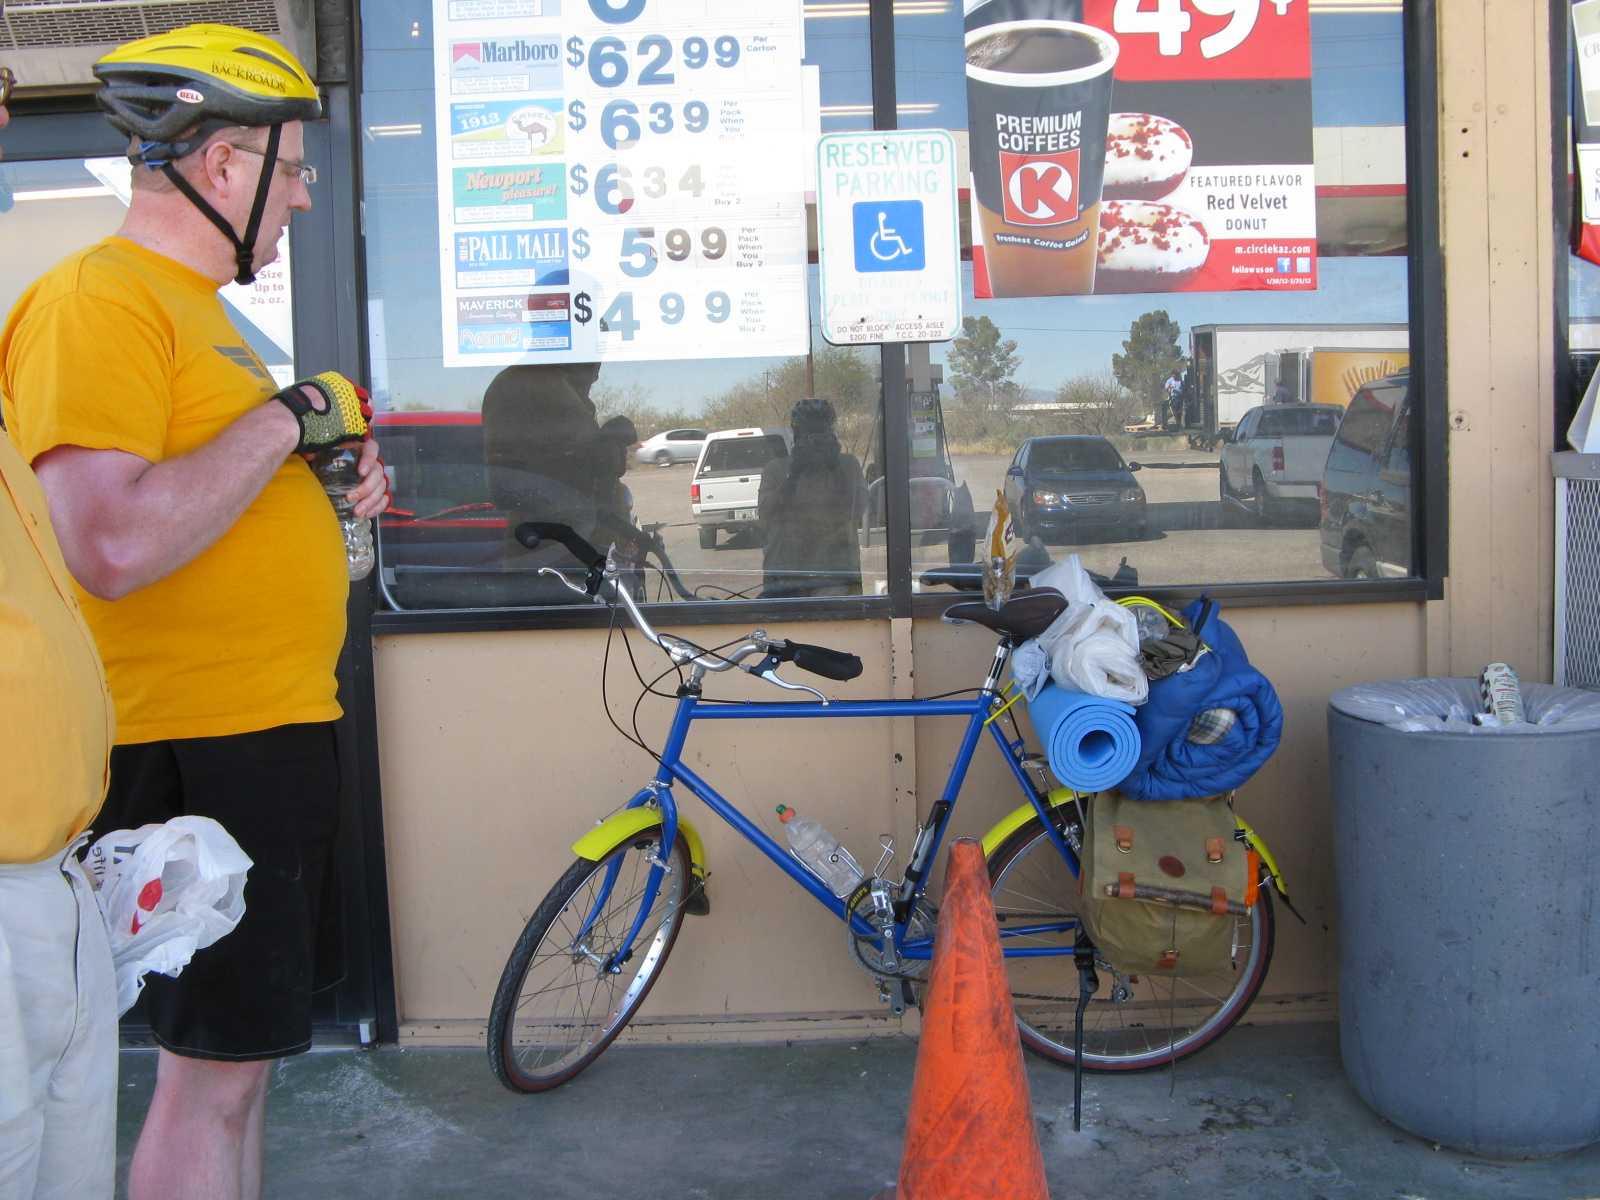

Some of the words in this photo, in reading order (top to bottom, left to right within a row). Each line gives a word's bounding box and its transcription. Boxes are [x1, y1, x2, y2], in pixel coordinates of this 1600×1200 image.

[482, 39, 559, 65] Marlboro
[745, 44, 777, 52] Carton
[211, 64, 287, 93] BACKROADS
[180, 90, 201, 101] BELL
[720, 108, 742, 116] Pack
[461, 112, 501, 130] 1913
[719, 117, 744, 125] When
[995, 111, 1082, 133] PREMIUM
[998, 130, 1080, 152] COFFEES
[826, 140, 945, 168] RESERVED
[465, 167, 543, 192] Newport
[836, 171, 939, 196] PARKING
[1190, 175, 1252, 189] FEATURED
[1255, 174, 1303, 188] FLAVOR
[1207, 194, 1234, 210] Red
[1240, 193, 1288, 210] Velvet
[1225, 218, 1267, 231] DONUT
[738, 235, 759, 243] Pack
[1033, 238, 1063, 249] Coffee
[468, 235, 512, 262] PALL
[516, 231, 565, 260] MALL
[737, 243, 763, 251] When
[1234, 244, 1311, 254] m.circlekaz.com
[741, 252, 759, 260] You
[260, 270, 284, 279] Size
[255, 283, 270, 293] Up
[272, 283, 285, 291] to
[459, 299, 523, 311] MAVERICK
[837, 326, 848, 334] DO
[850, 325, 864, 333] NOT
[866, 324, 889, 332] BLOCK
[895, 322, 922, 331] ACCESS
[926, 320, 945, 329] AISLE
